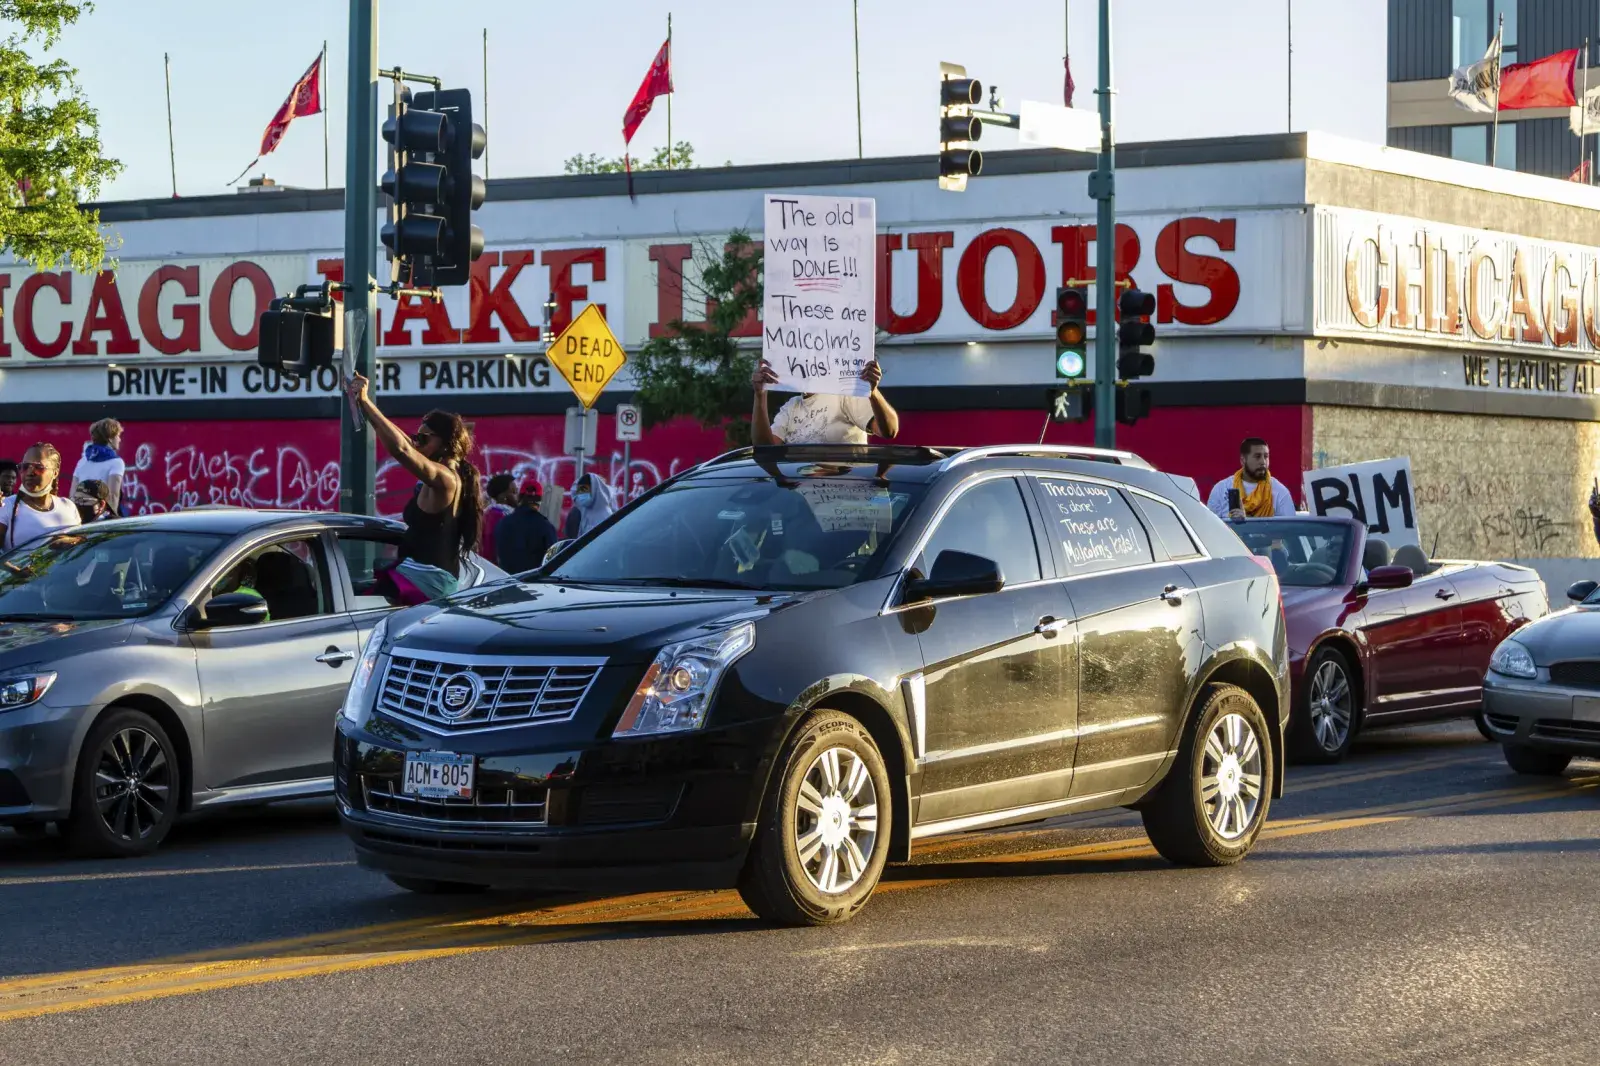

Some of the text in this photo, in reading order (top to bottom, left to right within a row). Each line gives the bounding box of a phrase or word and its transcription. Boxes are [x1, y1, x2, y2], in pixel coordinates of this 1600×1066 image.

[770, 199, 854, 230] The old
[792, 256, 858, 278] DONE!!!
[771, 294, 867, 322] These are
[566, 335, 613, 357] DEAD
[765, 325, 861, 352] Malcolm's
[107, 359, 550, 396] DRIVE-IN CUSTOER PARKING
[573, 362, 605, 383] END
[1040, 482, 1067, 497] The
[1084, 486, 1112, 504] way
[1311, 469, 1414, 535] BLM
[1060, 517, 1118, 535] These are
[407, 761, 469, 786] ACM 805
